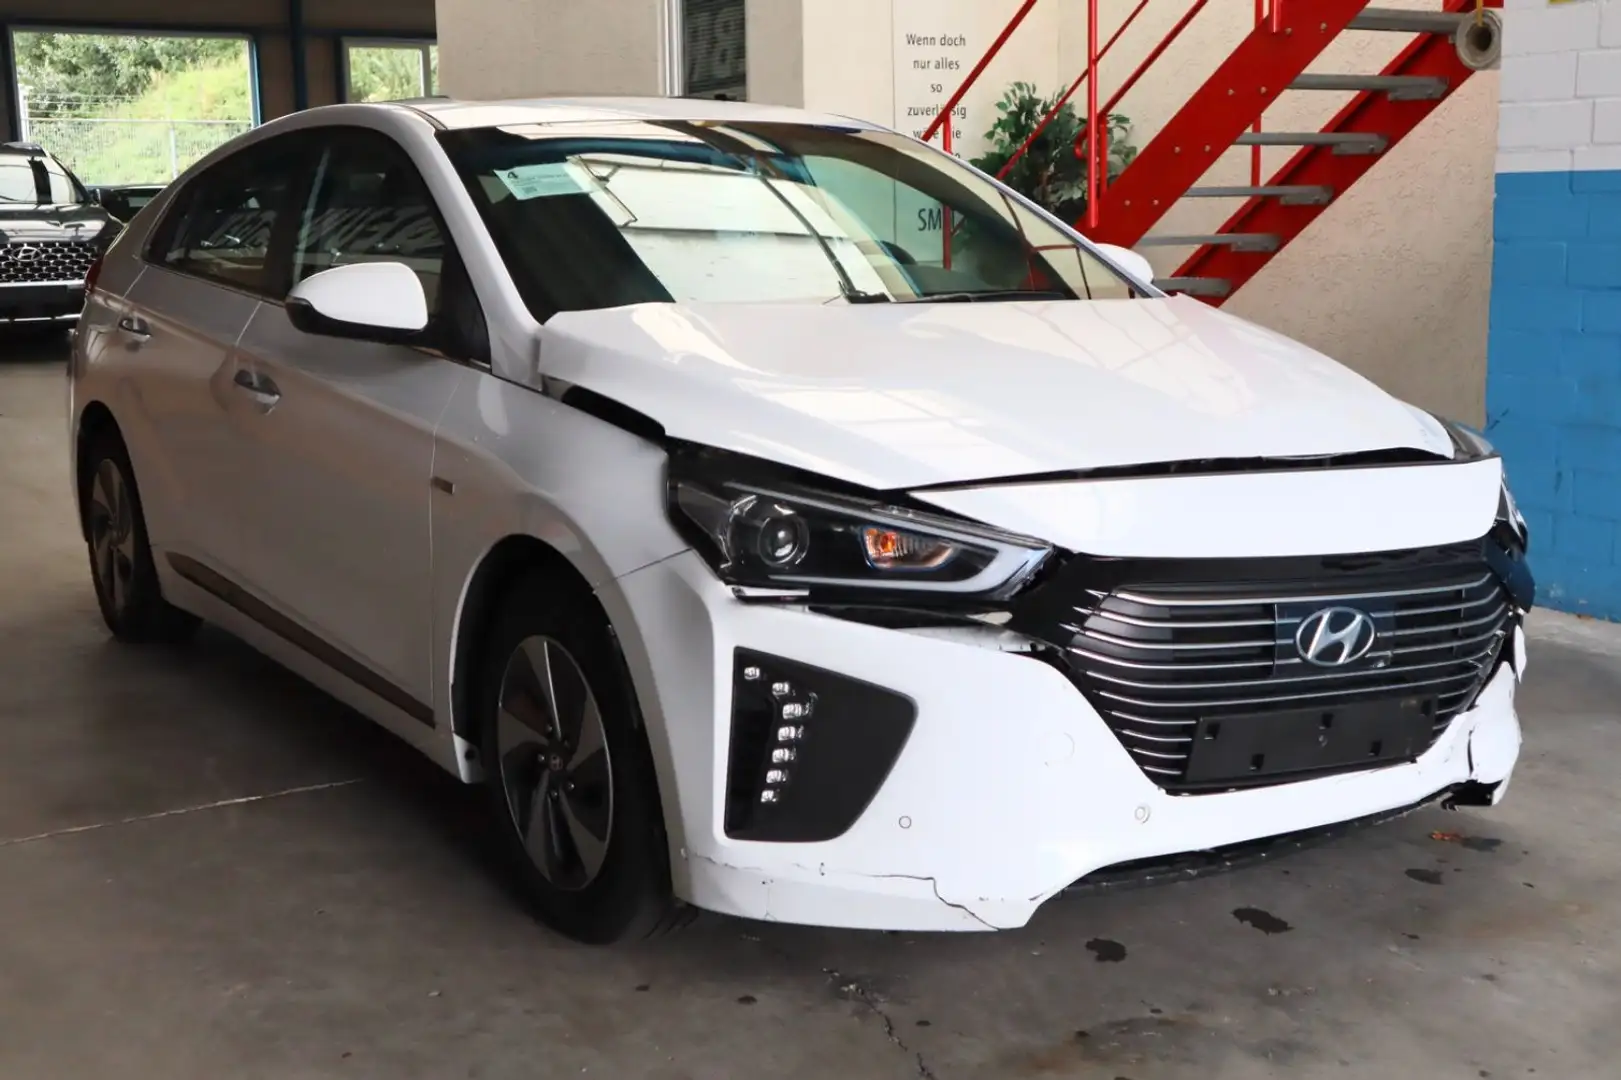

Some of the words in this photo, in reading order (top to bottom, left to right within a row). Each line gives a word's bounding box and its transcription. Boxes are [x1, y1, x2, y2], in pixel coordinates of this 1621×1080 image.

[906, 33, 936, 46] Wenn
[940, 33, 966, 46] doch
[913, 59, 931, 70] nur
[934, 56, 960, 70] alles
[930, 83, 943, 93] so
[907, 103, 967, 119] zuverlsig
